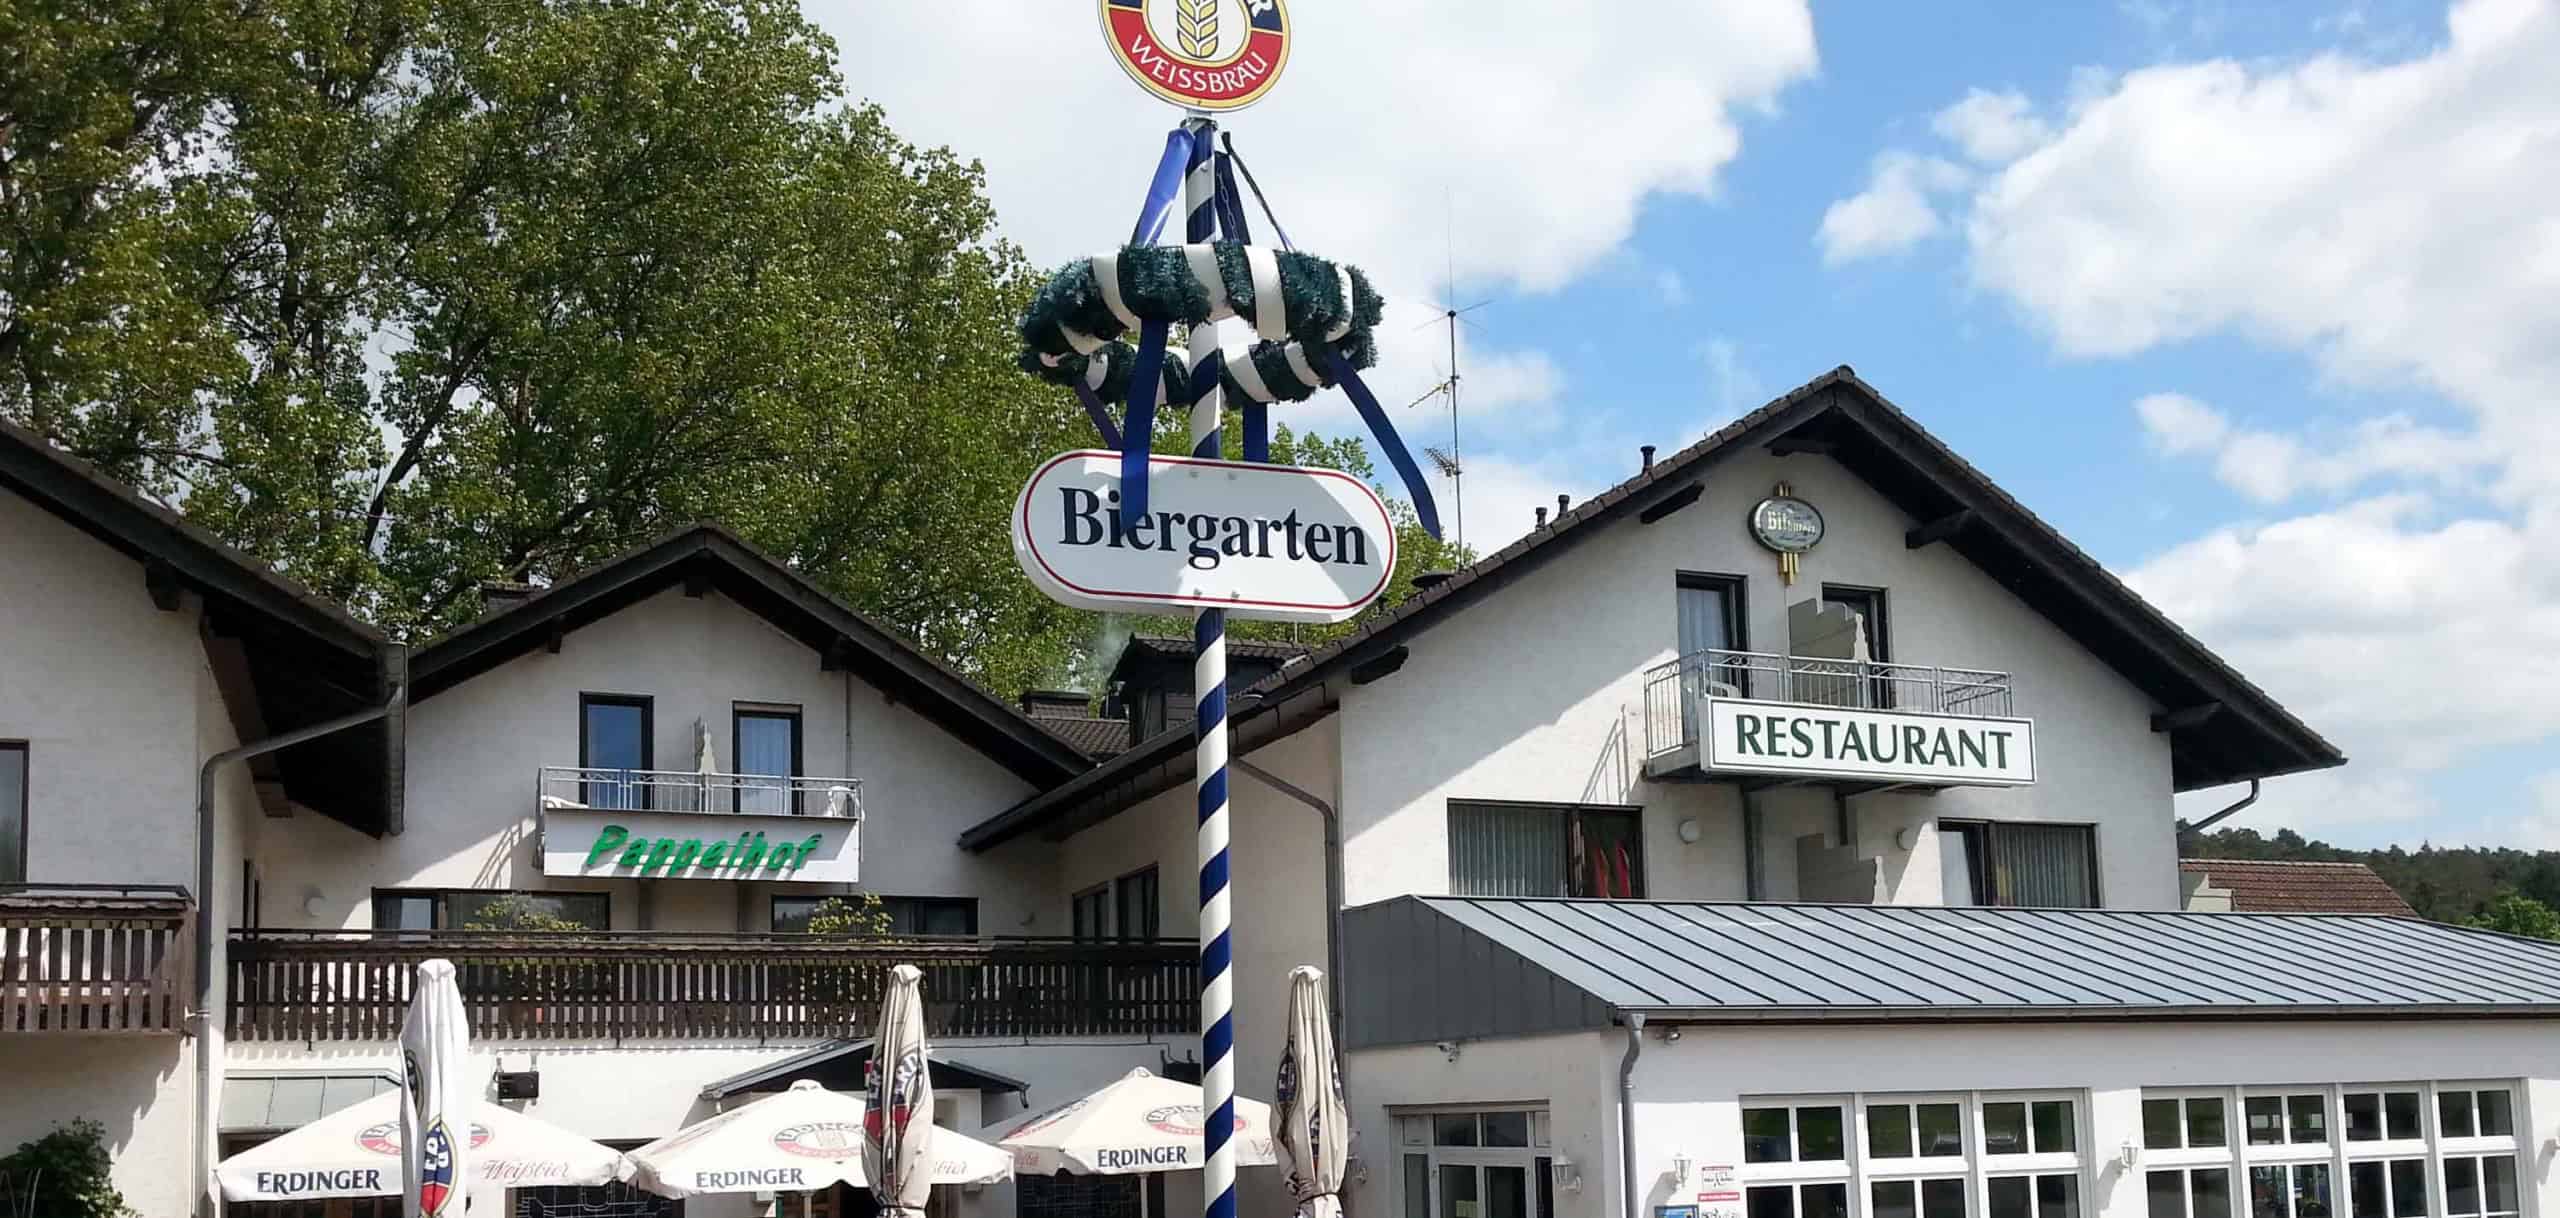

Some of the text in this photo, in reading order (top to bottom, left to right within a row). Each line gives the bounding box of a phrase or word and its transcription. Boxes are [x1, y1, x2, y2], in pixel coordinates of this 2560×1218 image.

[1132, 34, 1269, 93] WEISSBRÄU
[1058, 486, 1369, 571] Biergarten
[1735, 713, 2013, 770] RESTAURANT
[586, 824, 823, 877] Pappelhof
[256, 1168, 383, 1195] ERDINGER
[696, 1167, 805, 1189] ERDINGER
[1097, 1145, 1188, 1169] ERDINGER
